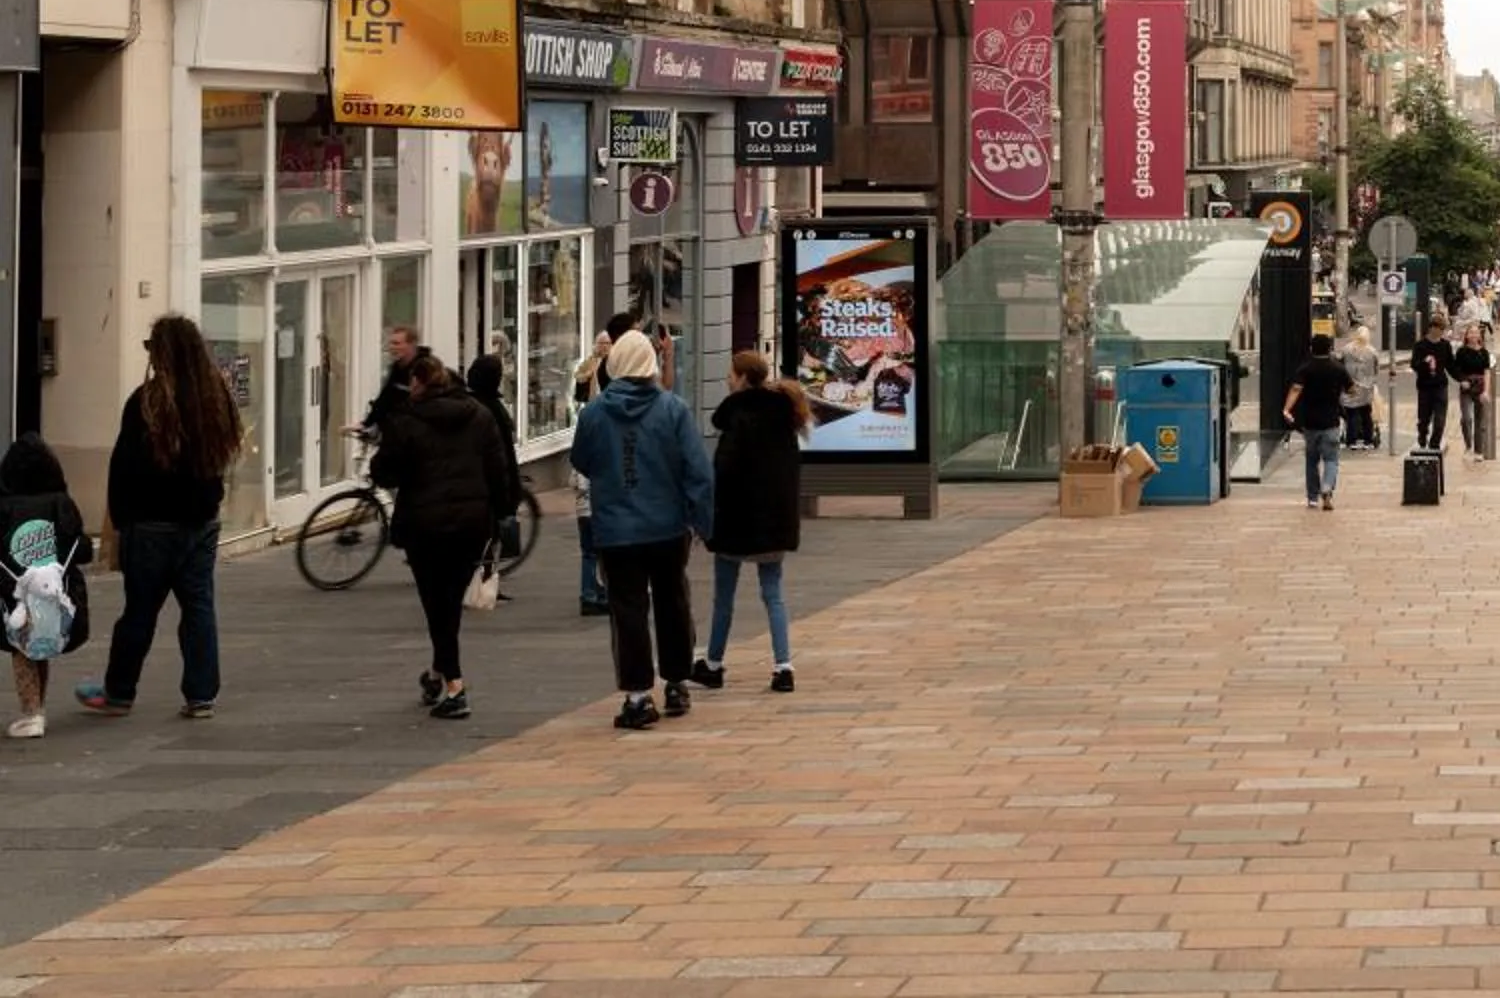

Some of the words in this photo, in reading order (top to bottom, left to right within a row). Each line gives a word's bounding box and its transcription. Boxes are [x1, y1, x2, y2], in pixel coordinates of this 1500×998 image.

[346, 20, 404, 44] LET
[575, 37, 614, 79] SHOP
[341, 103, 379, 115] 0131
[383, 104, 416, 118] 247
[420, 105, 466, 119] 3800
[1132, 17, 1155, 199] glasgow850.com
[613, 125, 669, 140] SCOTTISH
[746, 121, 773, 138] TO
[779, 121, 811, 138] LET
[981, 142, 1043, 172] 850
[820, 297, 897, 318] Steaks.
[820, 318, 898, 338] Raised.
